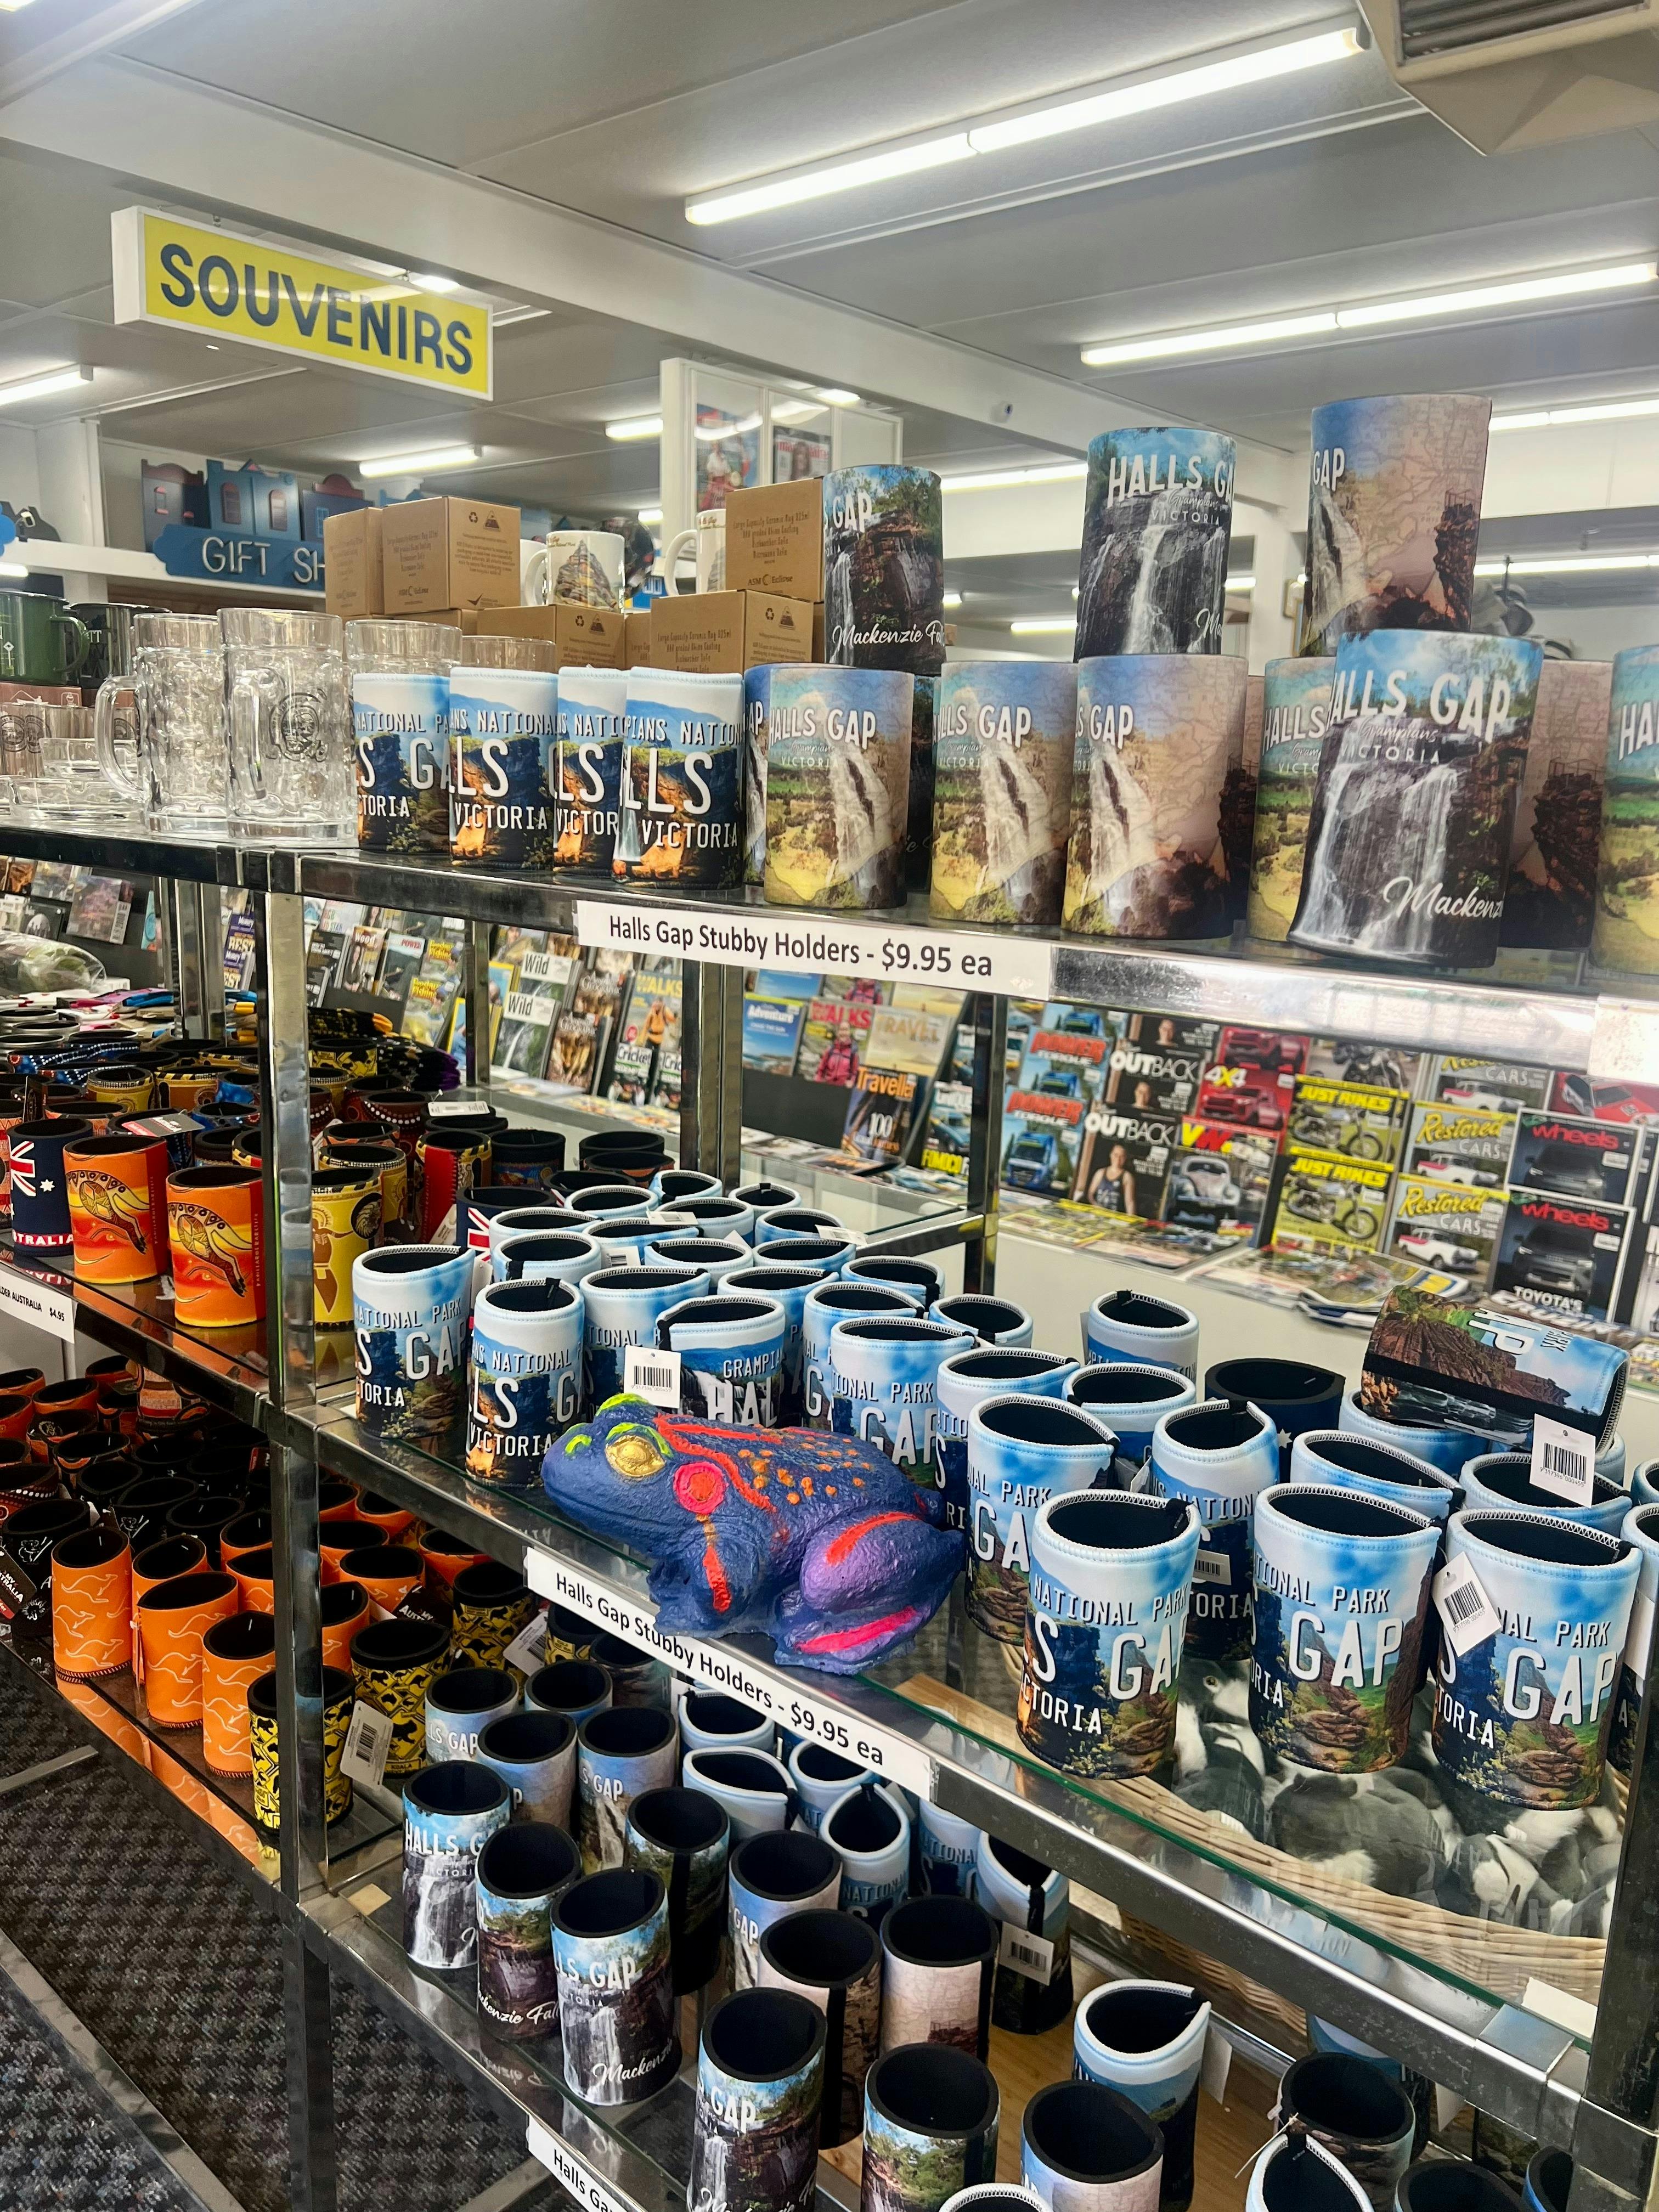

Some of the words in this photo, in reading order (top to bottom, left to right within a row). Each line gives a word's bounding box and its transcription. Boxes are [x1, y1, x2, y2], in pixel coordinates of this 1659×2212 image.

[160, 243, 473, 375] SOUVENIRS
[1107, 455, 1203, 507] HALLS
[1313, 448, 1345, 492] GAP
[833, 492, 872, 533] GAP
[1150, 511, 1220, 527] VICTORIA
[201, 536, 270, 575] GIFT
[771, 575, 793, 584] Eclipse
[832, 624, 924, 652] Mackenzie
[1430, 673, 1511, 744] GAP
[769, 708, 816, 750] HALLS
[827, 708, 877, 749] GAP
[979, 705, 1031, 751] GAP
[1090, 705, 1134, 751] GAP
[1262, 705, 1325, 754] HALLS
[781, 756, 838, 769] VICTORIA
[1340, 744, 1440, 765] VICTORIA
[454, 802, 548, 831] VICTORIA
[642, 819, 738, 849] VICTORIA
[355, 931, 378, 944] Wood
[610, 915, 651, 942] Halls
[656, 921, 694, 951] Gap
[699, 924, 768, 960] Stubby
[775, 932, 860, 964] Holders
[882, 938, 952, 973] $9.95
[961, 953, 992, 978] ea
[524, 952, 550, 975] Wild
[637, 974, 682, 998] WALKS
[509, 994, 533, 1017] Wild
[747, 1005, 794, 1024] Adventure
[618, 1046, 651, 1063] Cricket
[1029, 1031, 1107, 1063] POWER
[1110, 1049, 1198, 1082] OUTBACK
[1486, 1065, 1528, 1087] CARS
[857, 1067, 917, 1099] Traveller
[1007, 1091, 1085, 1126] POWER
[1296, 1085, 1336, 1108] JUST
[1337, 1092, 1392, 1114] BIKES
[869, 1113, 893, 1138] 100
[1085, 1114, 1175, 1147] OUTBACK
[1415, 1113, 1511, 1144] Restored
[1532, 1124, 1619, 1151] wheels
[1458, 1139, 1501, 1160] CARS
[1291, 1158, 1331, 1181] JUST
[1333, 1165, 1387, 1189] BIKES
[1399, 1185, 1487, 1217] Restored
[1439, 1212, 1482, 1235] CARS
[1521, 1203, 1610, 1232] wheels
[12, 1291, 42, 1312] AUSTRALIA
[50, 1307, 65, 1321] $4.95
[356, 1306, 423, 1329] NATIONAL
[432, 1297, 462, 1323] PARK
[1513, 1285, 1584, 1313] TOYOTA'S
[492, 1348, 572, 1374] NATIONAL
[891, 1382, 934, 1404] PARK
[1544, 1468, 1563, 1480] 317396
[1565, 1476, 1585, 1488] 000455
[1001, 1480, 1052, 1509] PARK
[1034, 1576, 1138, 1626] NATIONAL
[1152, 1583, 1190, 1621] PARK
[1332, 1587, 1390, 1614] PARK
[1555, 1620, 1612, 1648] PARK
[1289, 1610, 1405, 1689] GAP
[556, 1572, 593, 1609] Halls
[597, 1598, 630, 1631] Gap
[634, 1616, 694, 1670] Stubby
[699, 1651, 773, 1709] Holders
[790, 1701, 849, 1750] $9.95
[856, 1741, 884, 1767] ea
[1503, 1647, 1618, 1726] GAP
[448, 1731, 478, 1755] GAP
[592, 1774, 623, 1802] GAP
[405, 1818, 459, 1855] HALLS
[733, 1908, 759, 1945] GAP
[588, 1956, 636, 1990] GAP
[711, 2086, 757, 2135] GAP
[554, 2148, 586, 2196] Halls
